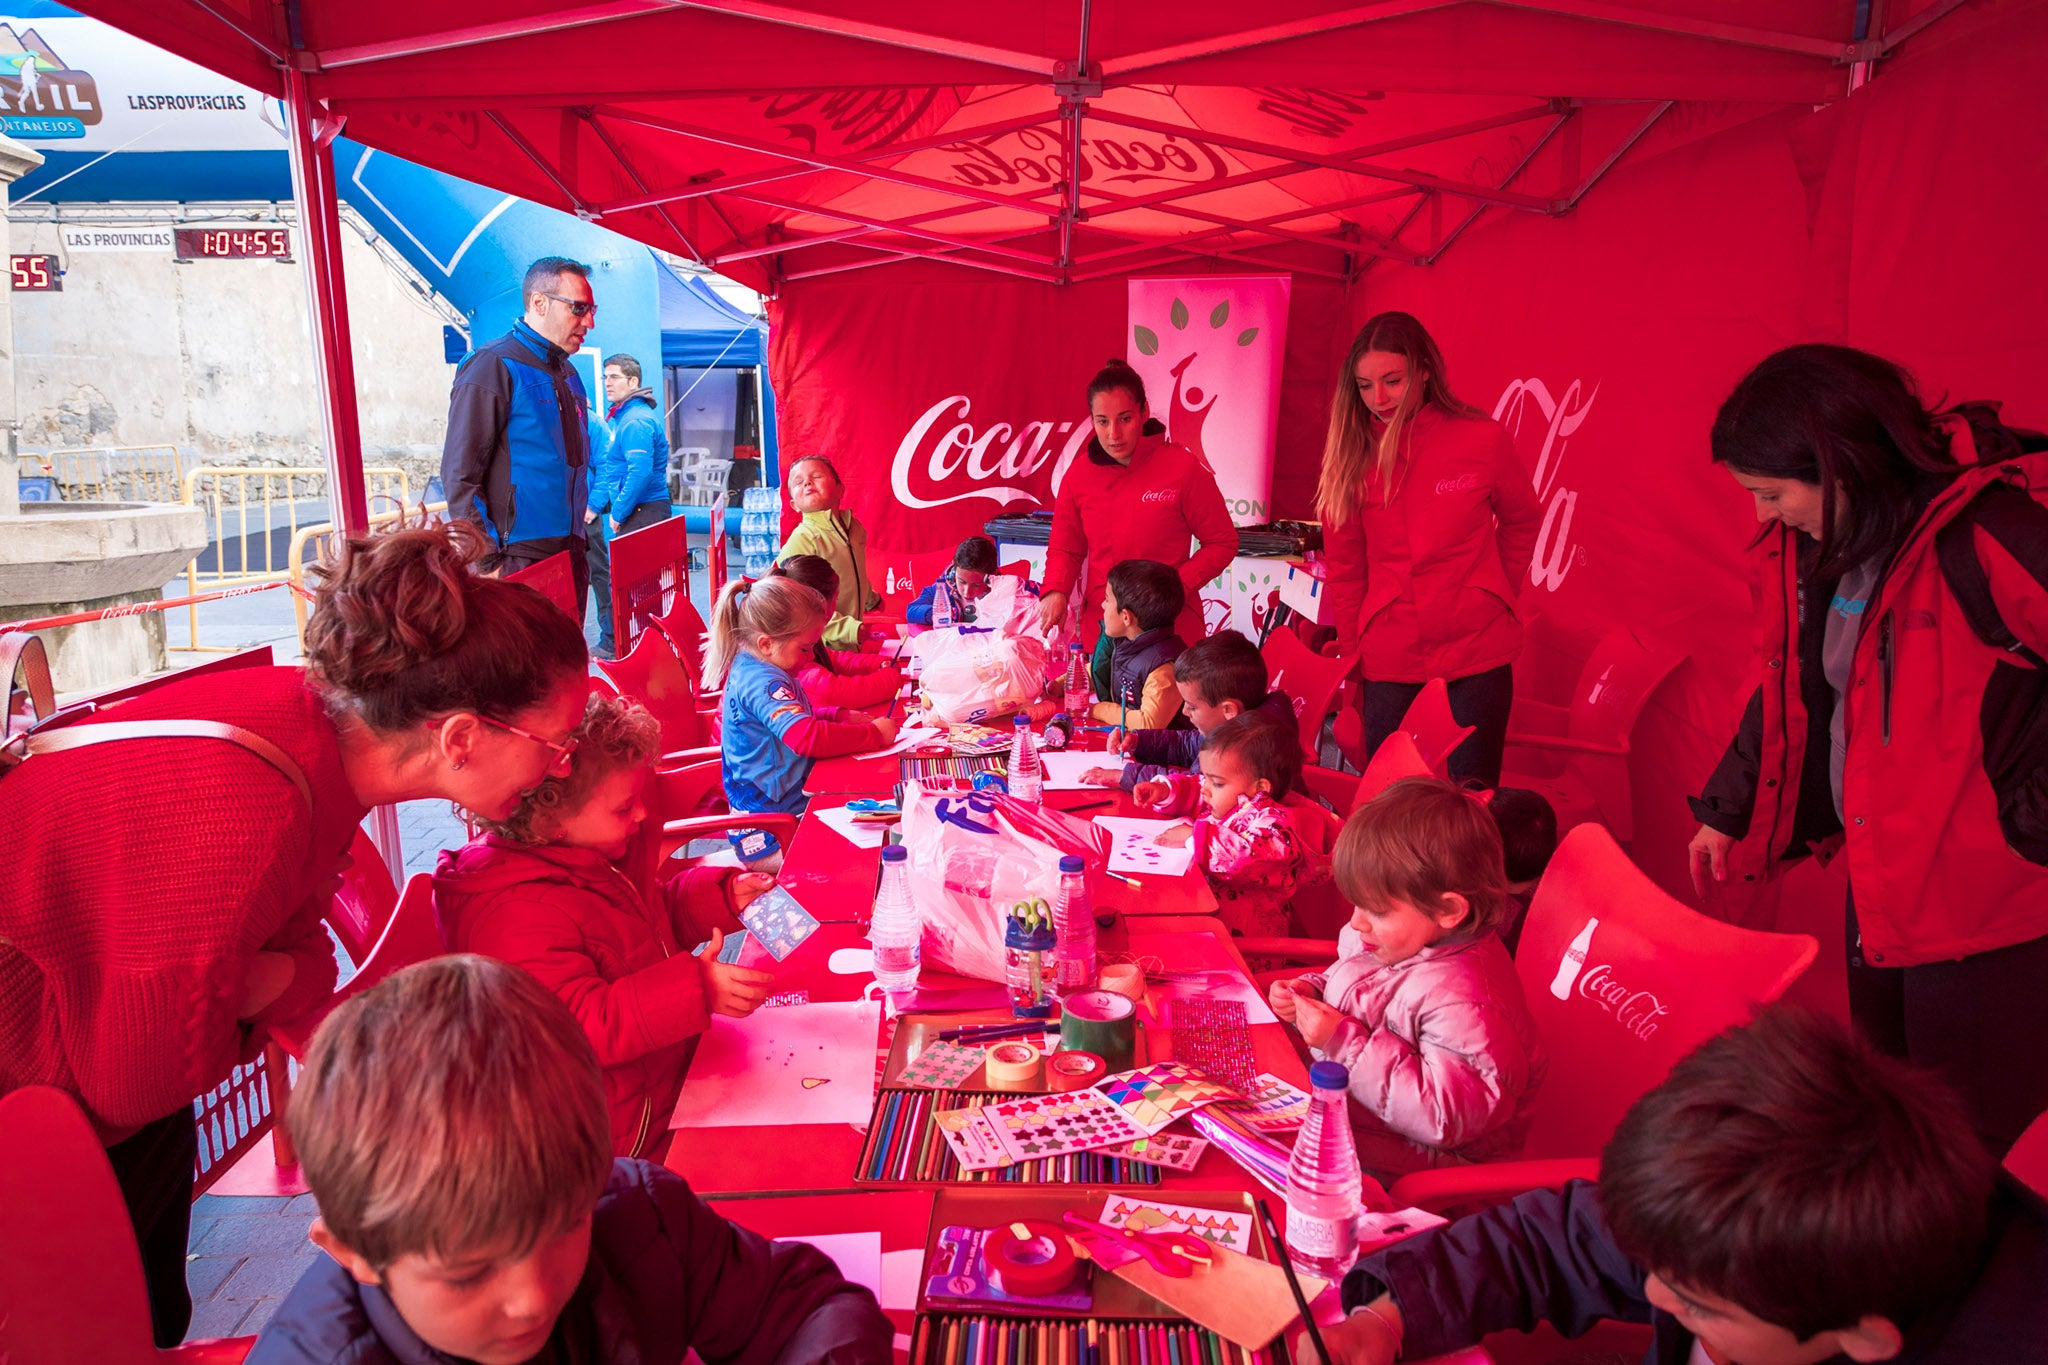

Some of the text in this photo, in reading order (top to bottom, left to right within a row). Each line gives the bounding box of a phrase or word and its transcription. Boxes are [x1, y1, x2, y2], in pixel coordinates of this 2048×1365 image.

[127, 95, 246, 110] LASPROVINCIAS
[67, 233, 171, 246] LAS PROVINCIAS
[203, 232, 285, 255] 1:04:55
[1579, 964, 1670, 1041] Coca-Cola
